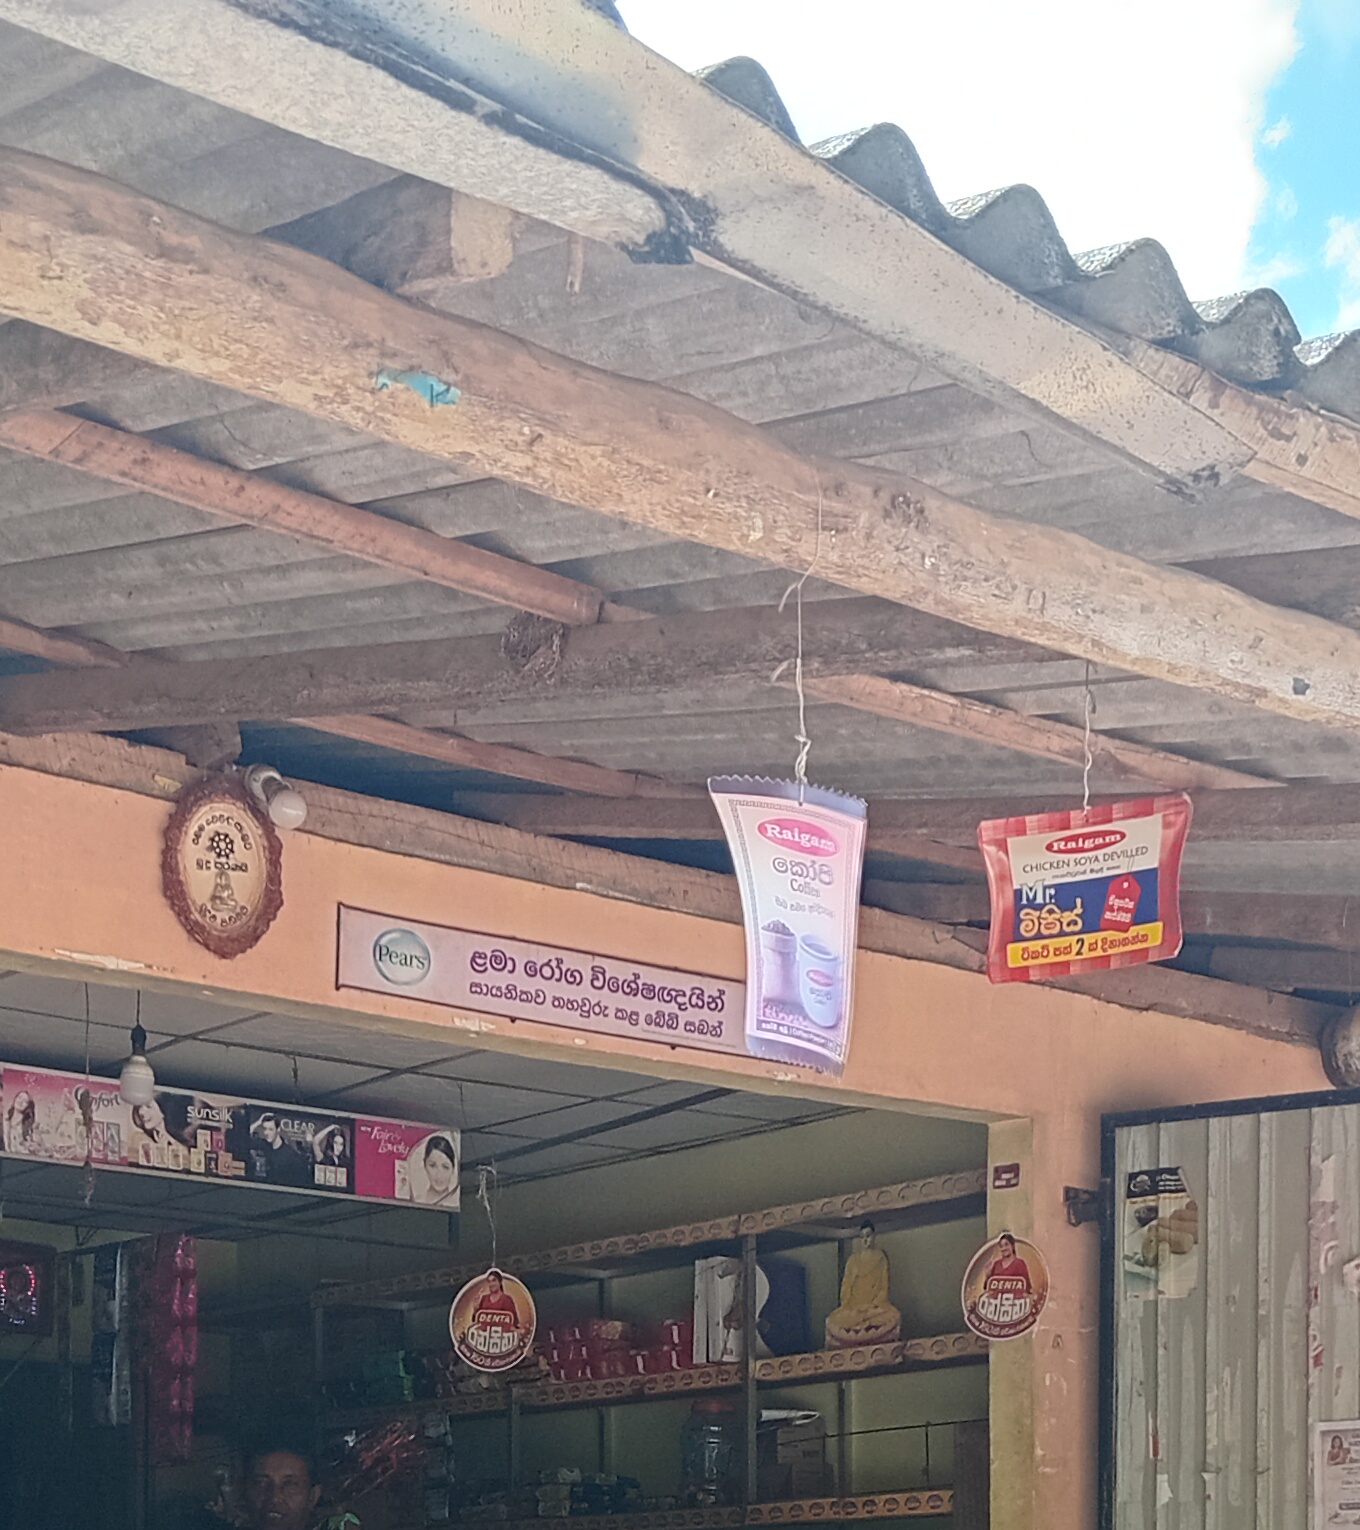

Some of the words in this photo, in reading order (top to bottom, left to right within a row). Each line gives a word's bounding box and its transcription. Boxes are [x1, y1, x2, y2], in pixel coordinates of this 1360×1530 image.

[765, 822, 837, 854] Raigam
[1051, 833, 1122, 853] Raigam
[772, 856, 834, 886] කෝපි
[1022, 858, 1071, 875] CHICKEN
[1073, 854, 1100, 867] SOYA
[1102, 845, 1149, 862] DEVILLED
[1019, 877, 1056, 905] Mr.
[377, 943, 427, 971] Pears
[1075, 937, 1086, 957] 2
[470, 948, 516, 975] ළමා
[523, 957, 584, 986] රෝග
[469, 980, 546, 1006] සායනිකව
[551, 993, 609, 1019] තහවුරු
[614, 1006, 640, 1026] කළ
[683, 1016, 723, 1039] සබන්
[280, 1117, 316, 1134] CLEAR
[990, 1280, 1024, 1290] DENTA
[478, 1313, 511, 1324] DENTA
